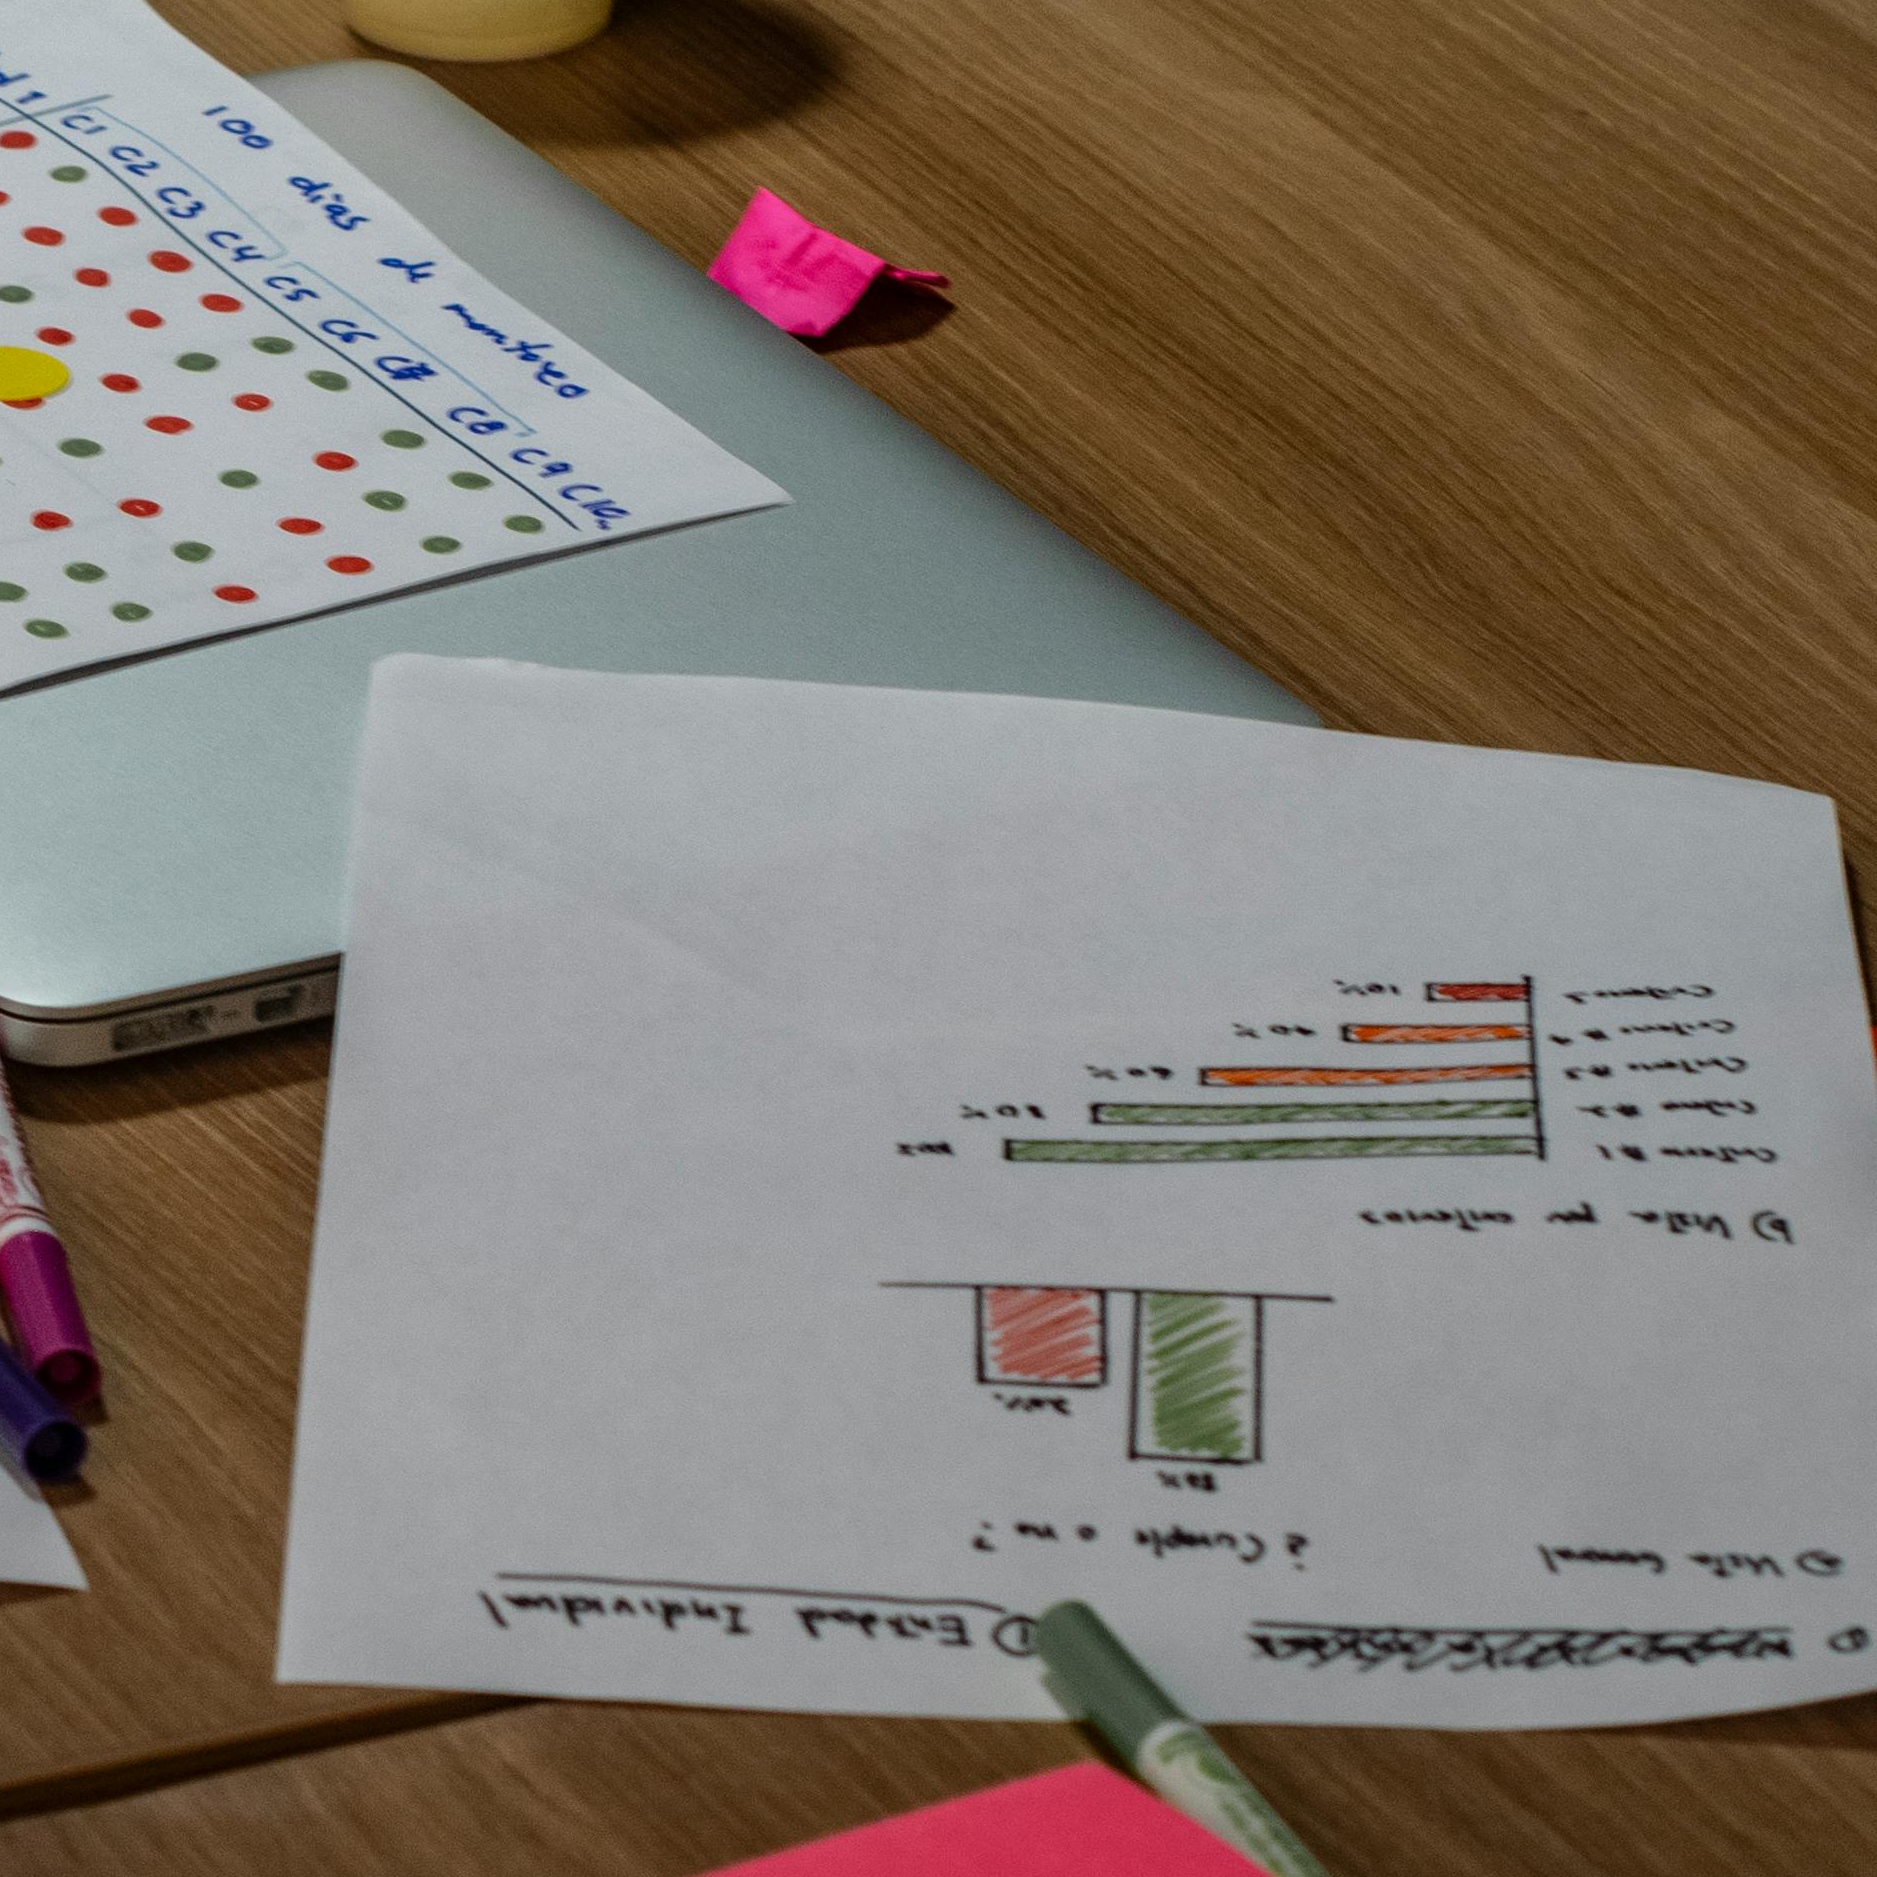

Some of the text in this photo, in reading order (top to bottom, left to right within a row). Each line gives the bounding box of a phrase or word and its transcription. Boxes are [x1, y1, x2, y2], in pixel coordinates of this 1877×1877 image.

[202, 104, 274, 151] 100
[107, 143, 160, 178] C2
[155, 184, 206, 220] C3
[205, 228, 266, 264] C4
[262, 273, 320, 303] C5
[508, 446, 573, 478] C9
